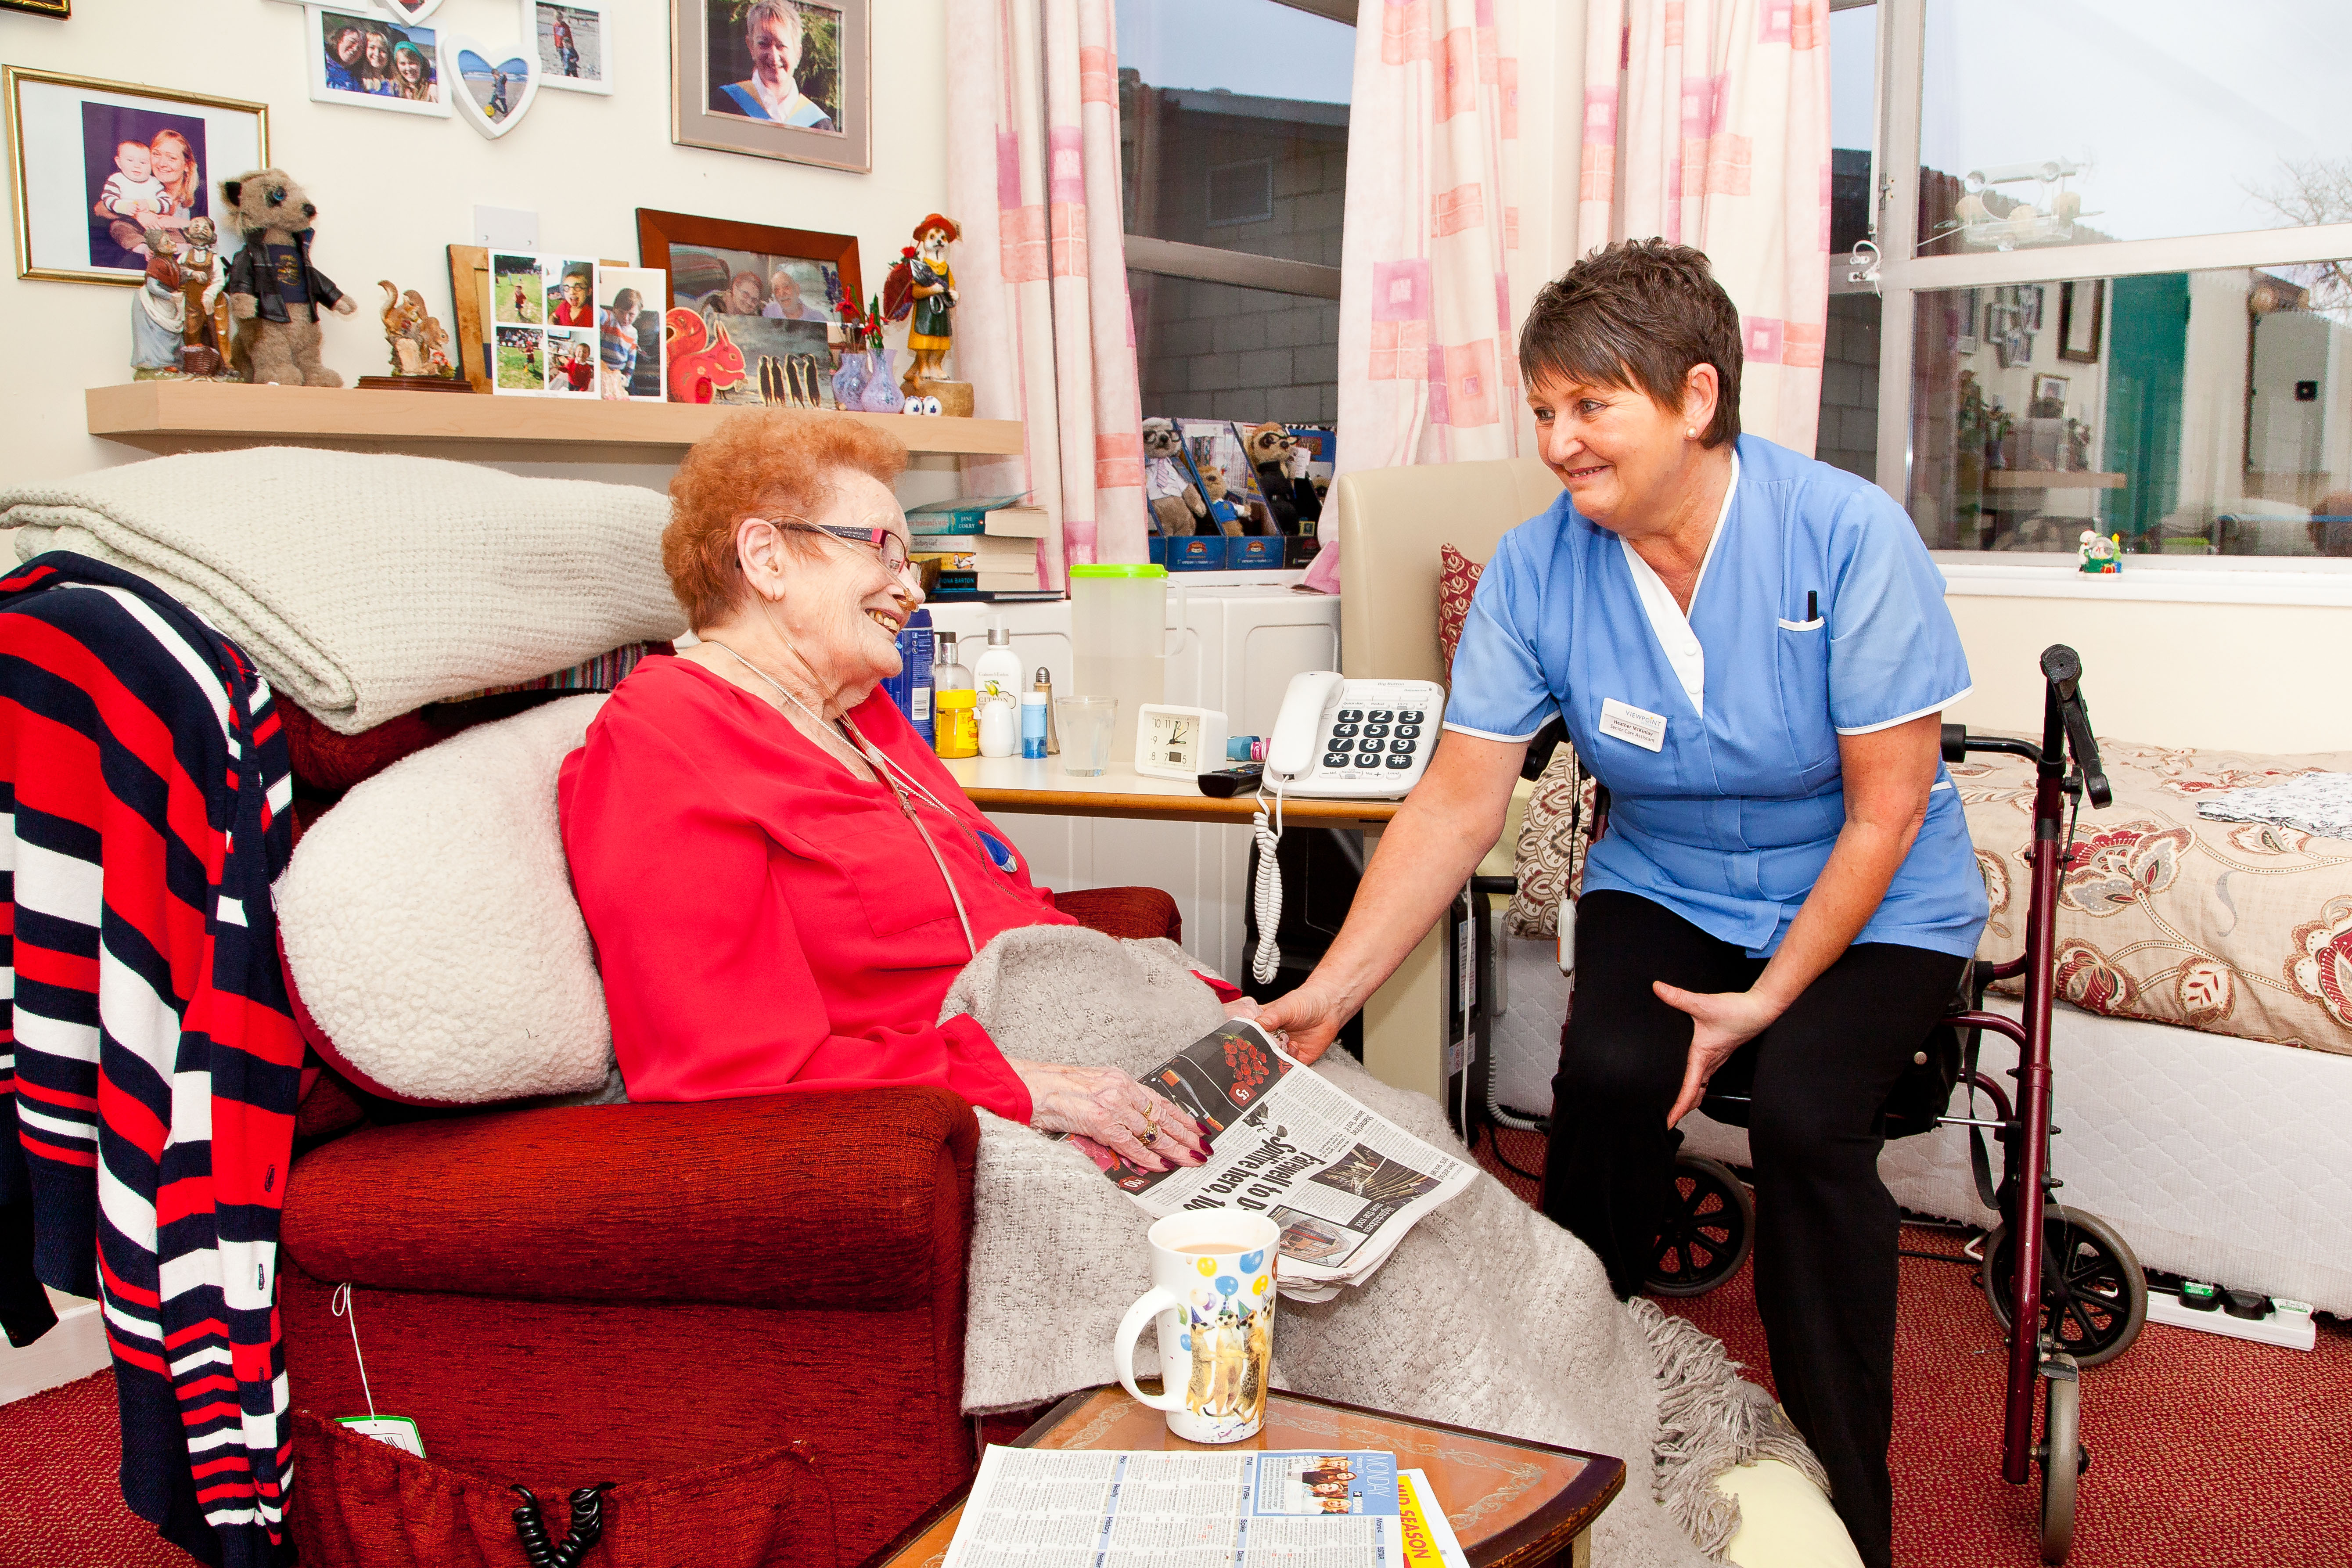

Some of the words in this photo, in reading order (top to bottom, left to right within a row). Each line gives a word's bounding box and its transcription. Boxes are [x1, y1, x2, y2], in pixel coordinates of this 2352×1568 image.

[1344, 710, 1355, 720] 1
[1374, 711, 1387, 720] 2
[1405, 711, 1417, 721] 3
[1154, 719, 1161, 728] 10
[1165, 720, 1171, 729] 11
[1187, 722, 1189, 730] 1
[1614, 719, 1632, 729] Heather
[1633, 726, 1654, 737] McKinlay
[1339, 724, 1352, 734] 4
[1370, 725, 1382, 734] 5
[1401, 725, 1413, 735] 6
[1153, 736, 1157, 744] 9
[1336, 738, 1349, 748] 7
[1635, 733, 1654, 743] Assistant
[1365, 739, 1378, 749] 8
[1397, 740, 1409, 750] 9
[1151, 752, 1156, 760] 8
[1165, 753, 1168, 761] 7
[1182, 755, 1187, 764] 5
[1361, 754, 1374, 764] 0
[1392, 755, 1406, 764] #
[1236, 1089, 1249, 1100] £5
[1353, 1110, 1366, 1122] lawyer
[1358, 1115, 1374, 1130] Shamed
[1238, 1136, 1296, 1173] Spitfire
[1261, 1150, 1327, 1187] Farewell
[1448, 1162, 1458, 1170] Down
[1201, 1167, 1258, 1193] hero,
[1248, 1184, 1282, 1197] to
[1370, 1203, 1384, 1212] raise
[1363, 1209, 1375, 1218] the
[1354, 1218, 1366, 1228] roof
[1361, 1206, 1395, 1233] Nightclubbers
[1355, 1456, 1364, 1468] February
[1366, 1456, 1390, 1497] MONDAY
[1111, 1484, 1120, 1497] Really
[1398, 1484, 1410, 1505] MID
[1103, 1517, 1113, 1534] History
[1399, 1510, 1431, 1558] SEASON
